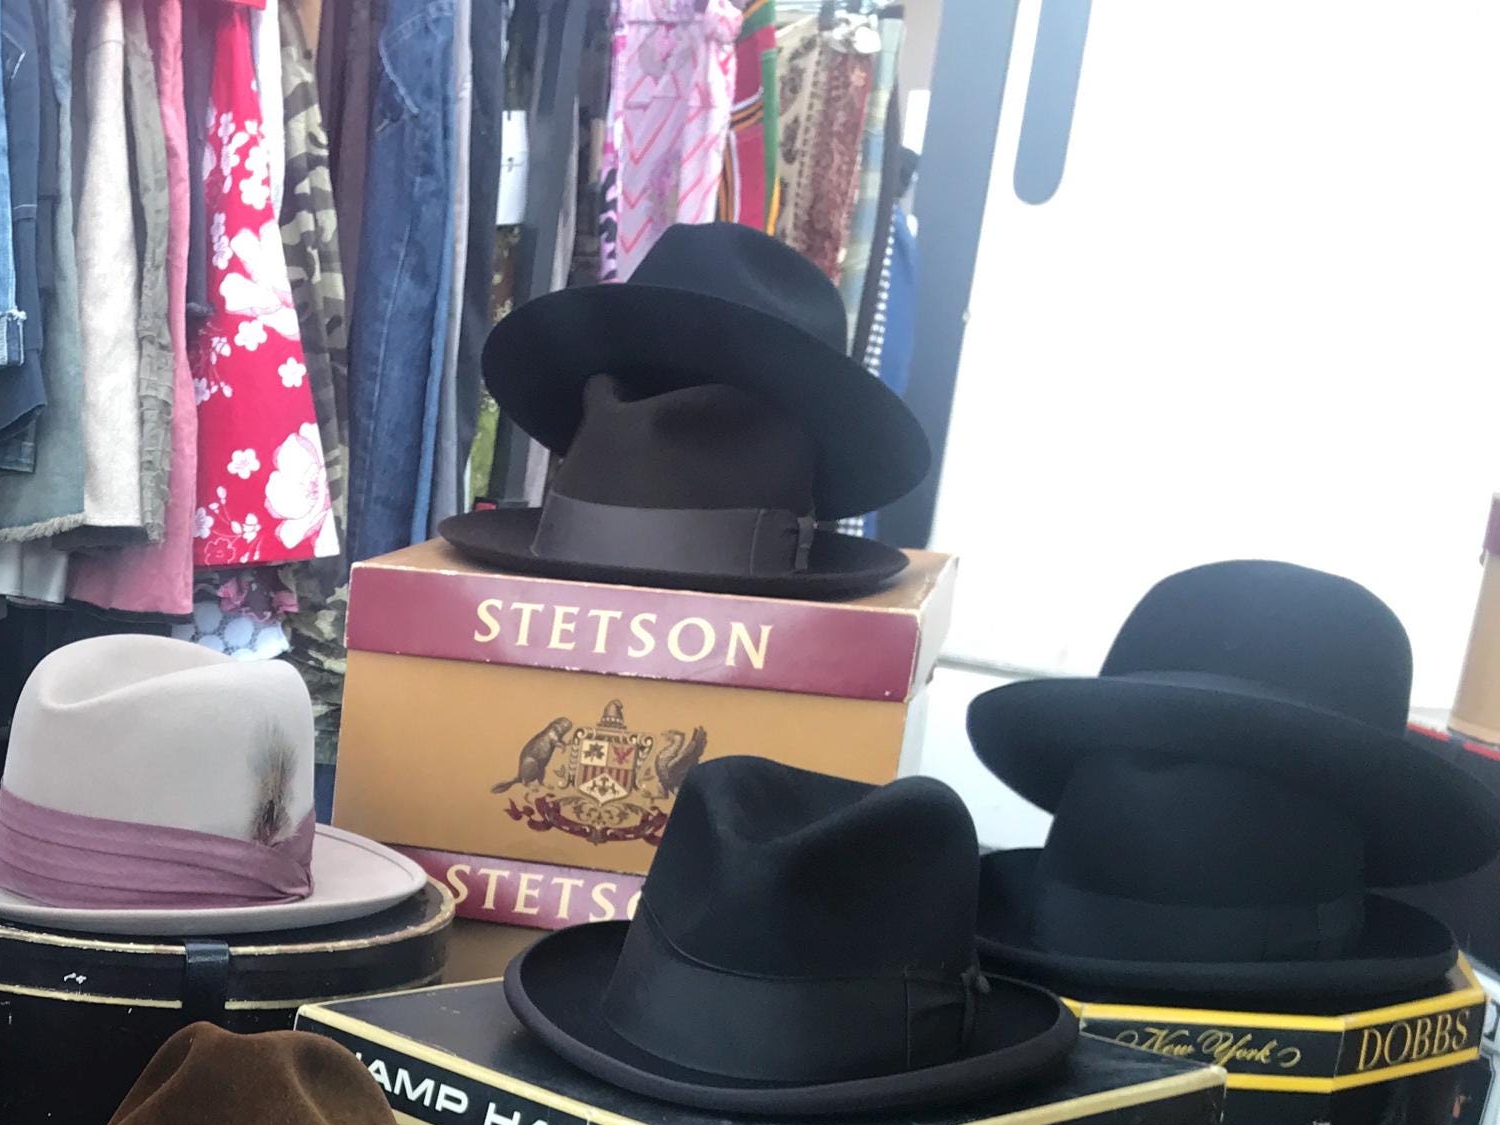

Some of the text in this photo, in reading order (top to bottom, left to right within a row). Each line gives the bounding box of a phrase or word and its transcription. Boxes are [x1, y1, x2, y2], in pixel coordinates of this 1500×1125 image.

[473, 598, 773, 670] STETSON
[1138, 1026, 1279, 1066] New York
[1356, 1011, 1471, 1072] DOBBS
[356, 1052, 469, 1115] AMP
